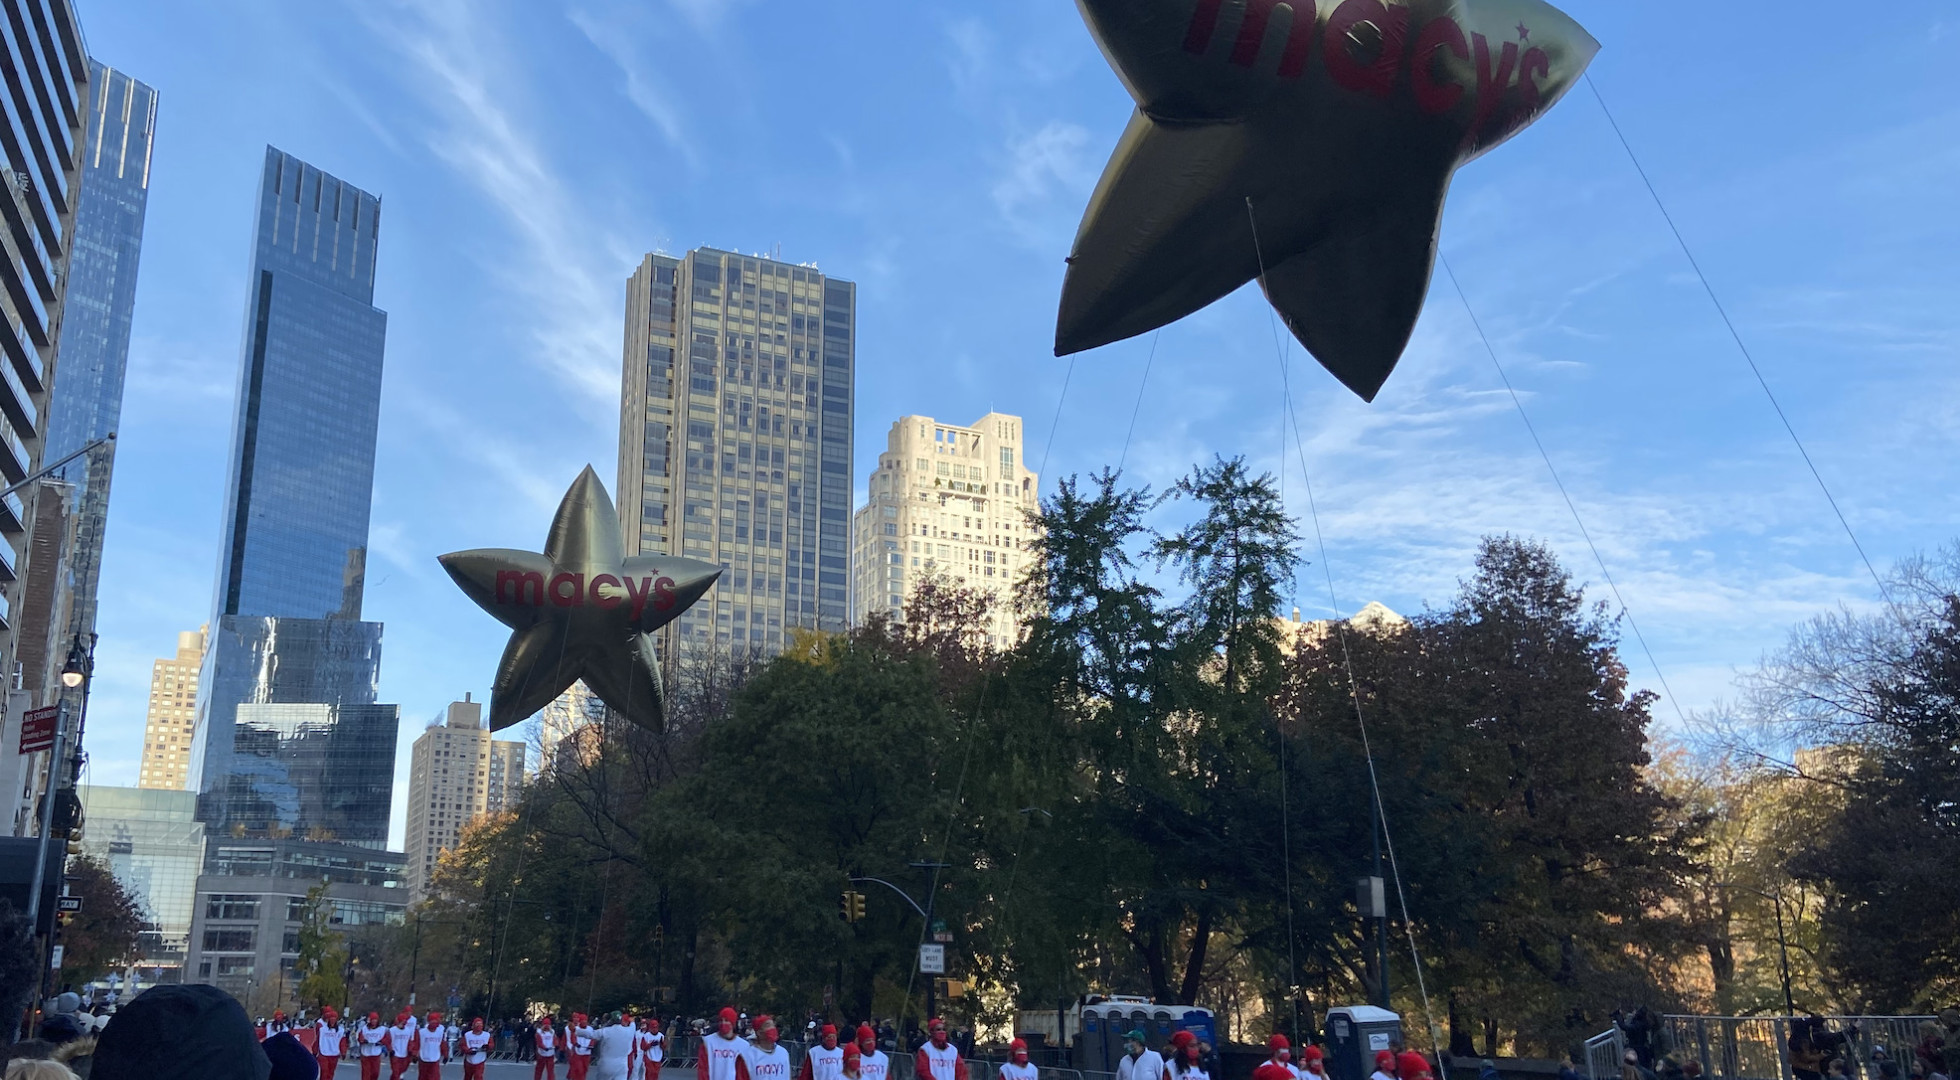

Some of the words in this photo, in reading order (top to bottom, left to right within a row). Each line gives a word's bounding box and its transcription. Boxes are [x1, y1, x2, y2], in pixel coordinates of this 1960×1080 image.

[1182, 0, 1550, 147] macy's
[495, 568, 677, 621] macy's
[25, 714, 33, 723] NO
[755, 1063, 784, 1076] macy's
